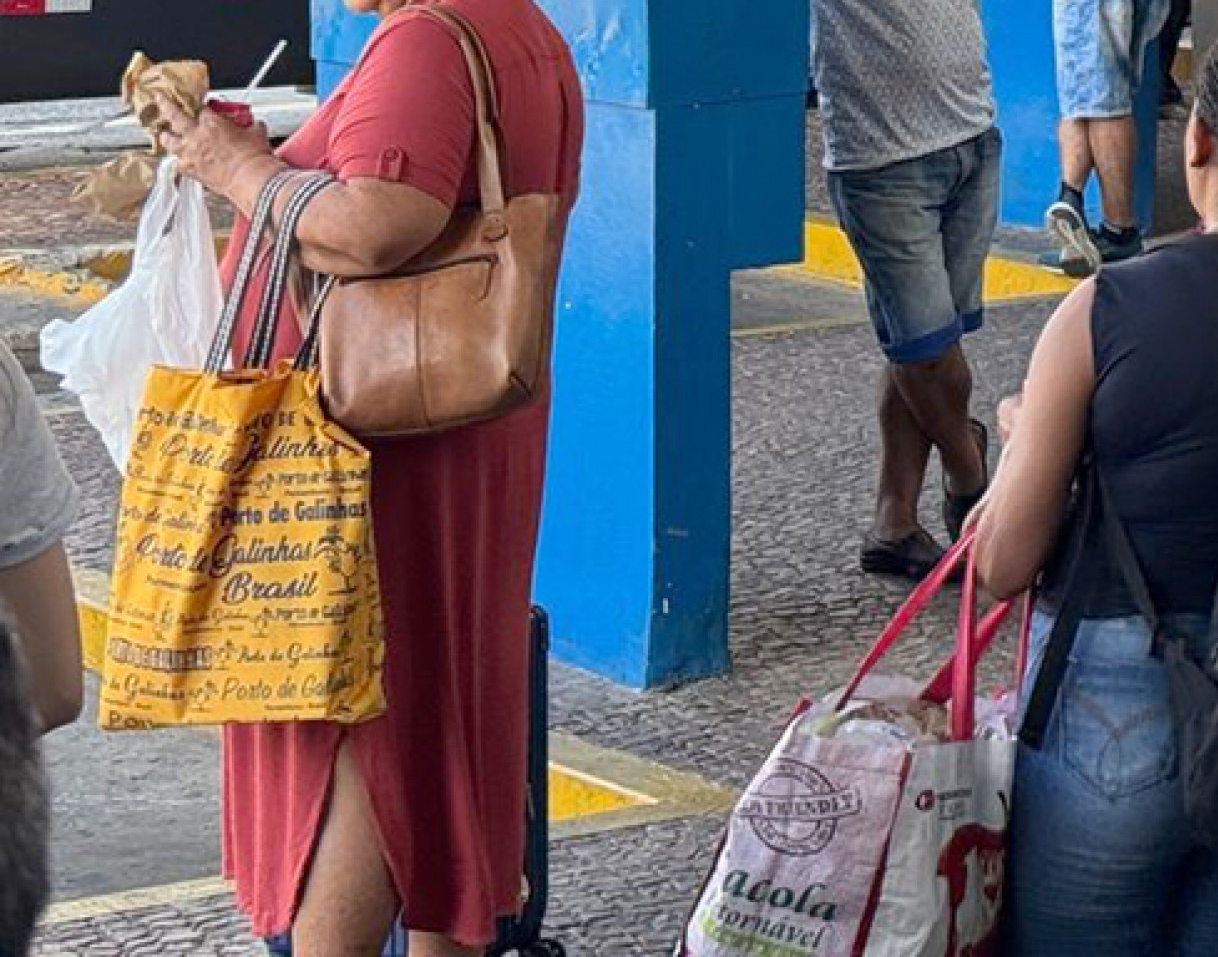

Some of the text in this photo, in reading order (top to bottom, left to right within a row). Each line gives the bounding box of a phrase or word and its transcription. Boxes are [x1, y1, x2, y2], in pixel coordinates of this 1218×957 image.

[216, 504, 261, 527] Porto
[268, 500, 290, 522] de
[293, 497, 367, 522] Galinhas
[221, 569, 319, 604] Brasil
